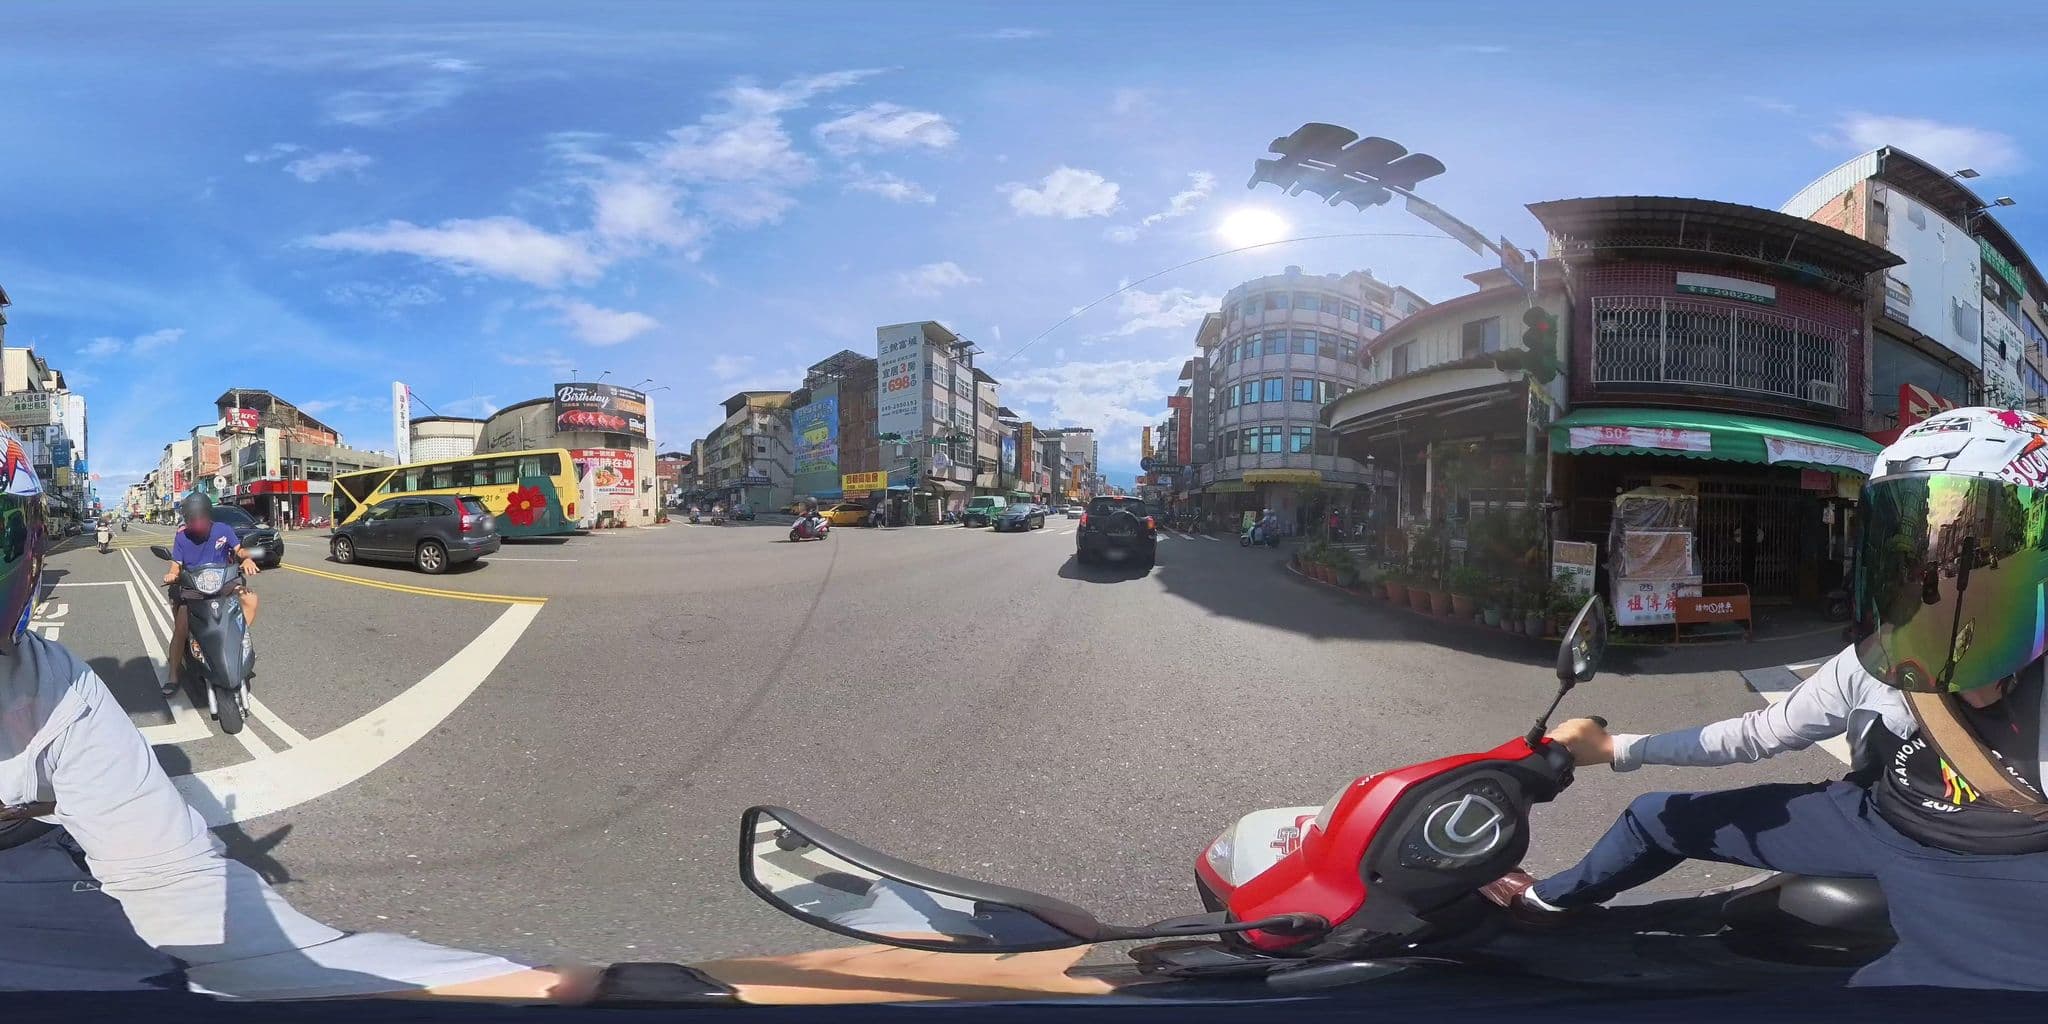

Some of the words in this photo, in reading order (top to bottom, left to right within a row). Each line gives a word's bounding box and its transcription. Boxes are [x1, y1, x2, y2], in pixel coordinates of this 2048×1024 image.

[888, 375, 910, 392] 698
[558, 386, 610, 408] Birthday
[240, 412, 257, 420] KFC
[239, 483, 252, 496] KFC
